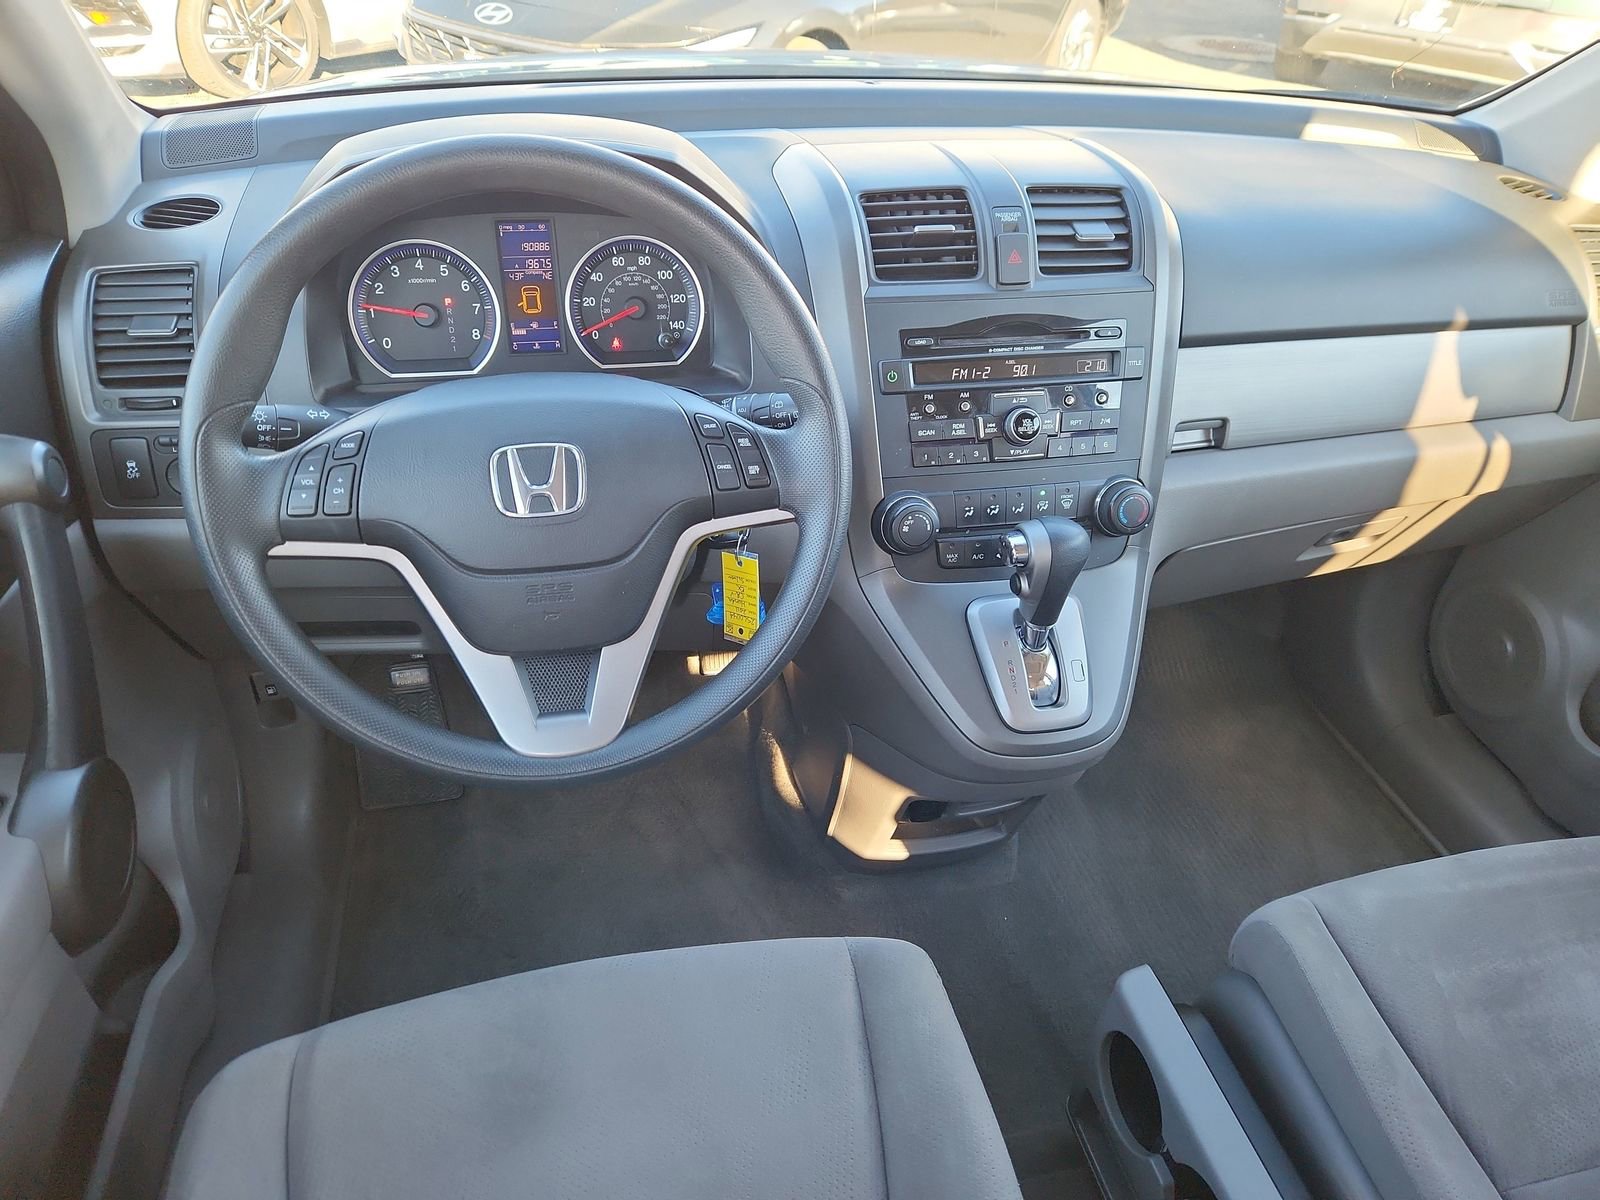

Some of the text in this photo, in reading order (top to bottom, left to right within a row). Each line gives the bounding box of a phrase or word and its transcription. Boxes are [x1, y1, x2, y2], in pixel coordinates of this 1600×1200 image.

[521, 242, 550, 252] 190886
[414, 258, 424, 271] 4
[611, 256, 625, 267] 60
[638, 256, 651, 266] 80
[390, 265, 400, 278] 3
[439, 264, 449, 277] 5
[542, 271, 553, 280] NE
[657, 270, 673, 280] 100
[590, 272, 603, 282] 40
[374, 282, 385, 295] 2
[461, 280, 470, 292] 6
[444, 297, 452, 306] P
[582, 297, 596, 307] 20
[670, 294, 686, 303] 120
[472, 303, 481, 315] 7
[669, 320, 685, 330] 140
[471, 328, 481, 340] 8
[591, 330, 599, 340] 0
[382, 337, 392, 350] 0
[917, 429, 935, 437] SCAN
